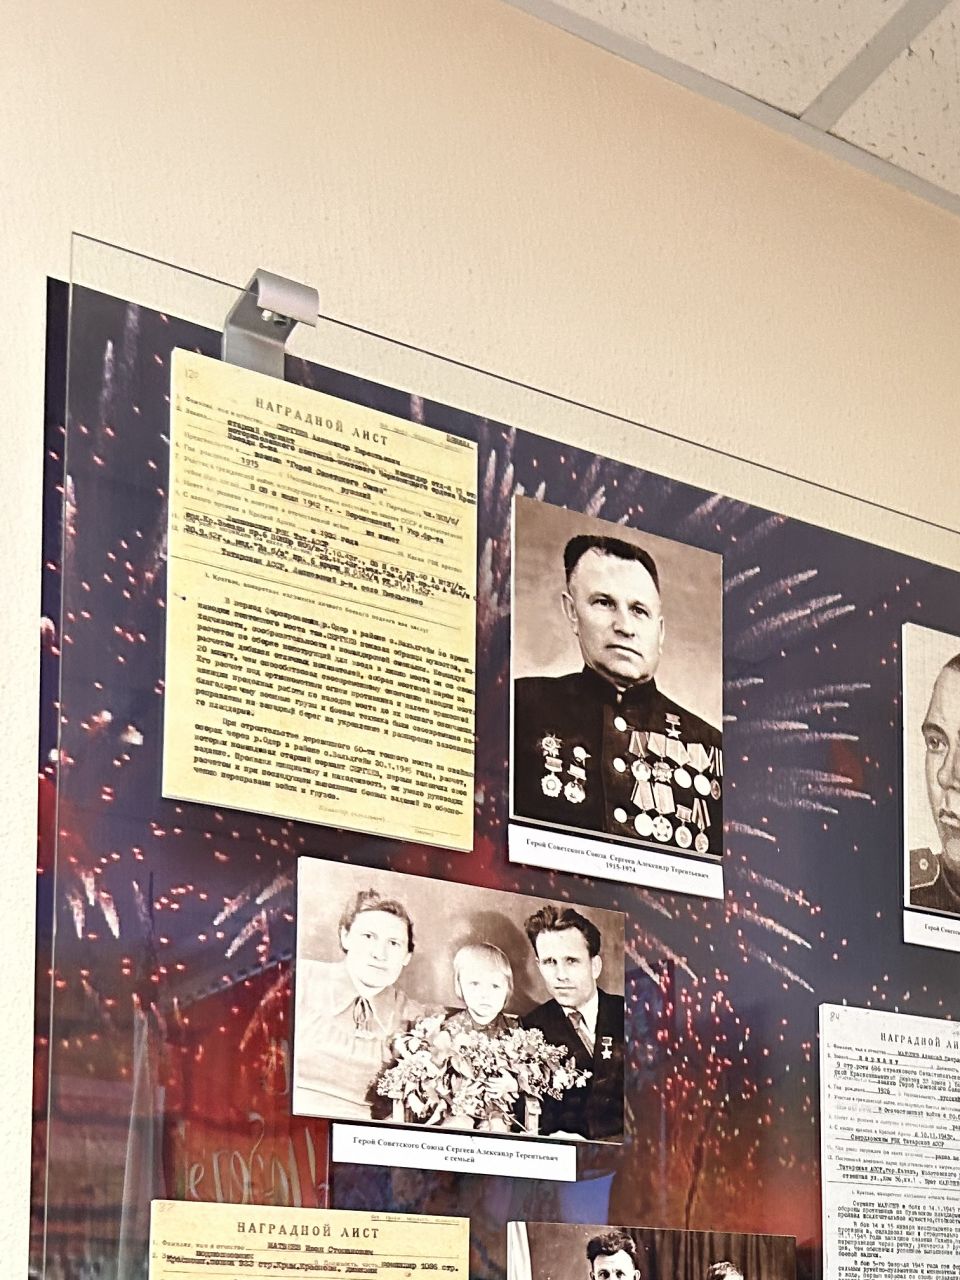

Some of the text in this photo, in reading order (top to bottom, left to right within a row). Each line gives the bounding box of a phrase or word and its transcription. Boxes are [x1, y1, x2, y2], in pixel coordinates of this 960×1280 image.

[255, 397, 343, 432] НАГРАДНОЙ
[351, 427, 387, 445] ЛИСТ
[241, 456, 259, 468] 1915
[526, 838, 545, 847] Герой
[547, 842, 584, 854] Советского
[585, 849, 606, 859] Союза
[609, 854, 635, 864] Сергеев
[637, 859, 669, 872] Александр
[605, 861, 635, 872] 1915-1974
[924, 923, 939, 931] Герой
[880, 1032, 940, 1047] НАГРАДНОЙ
[353, 1136, 558, 1160] Герой Советского Союза Сергеев Александр Терентьевич
[237, 1221, 378, 1238] НАГРАДНОЙ ЛИСТ
